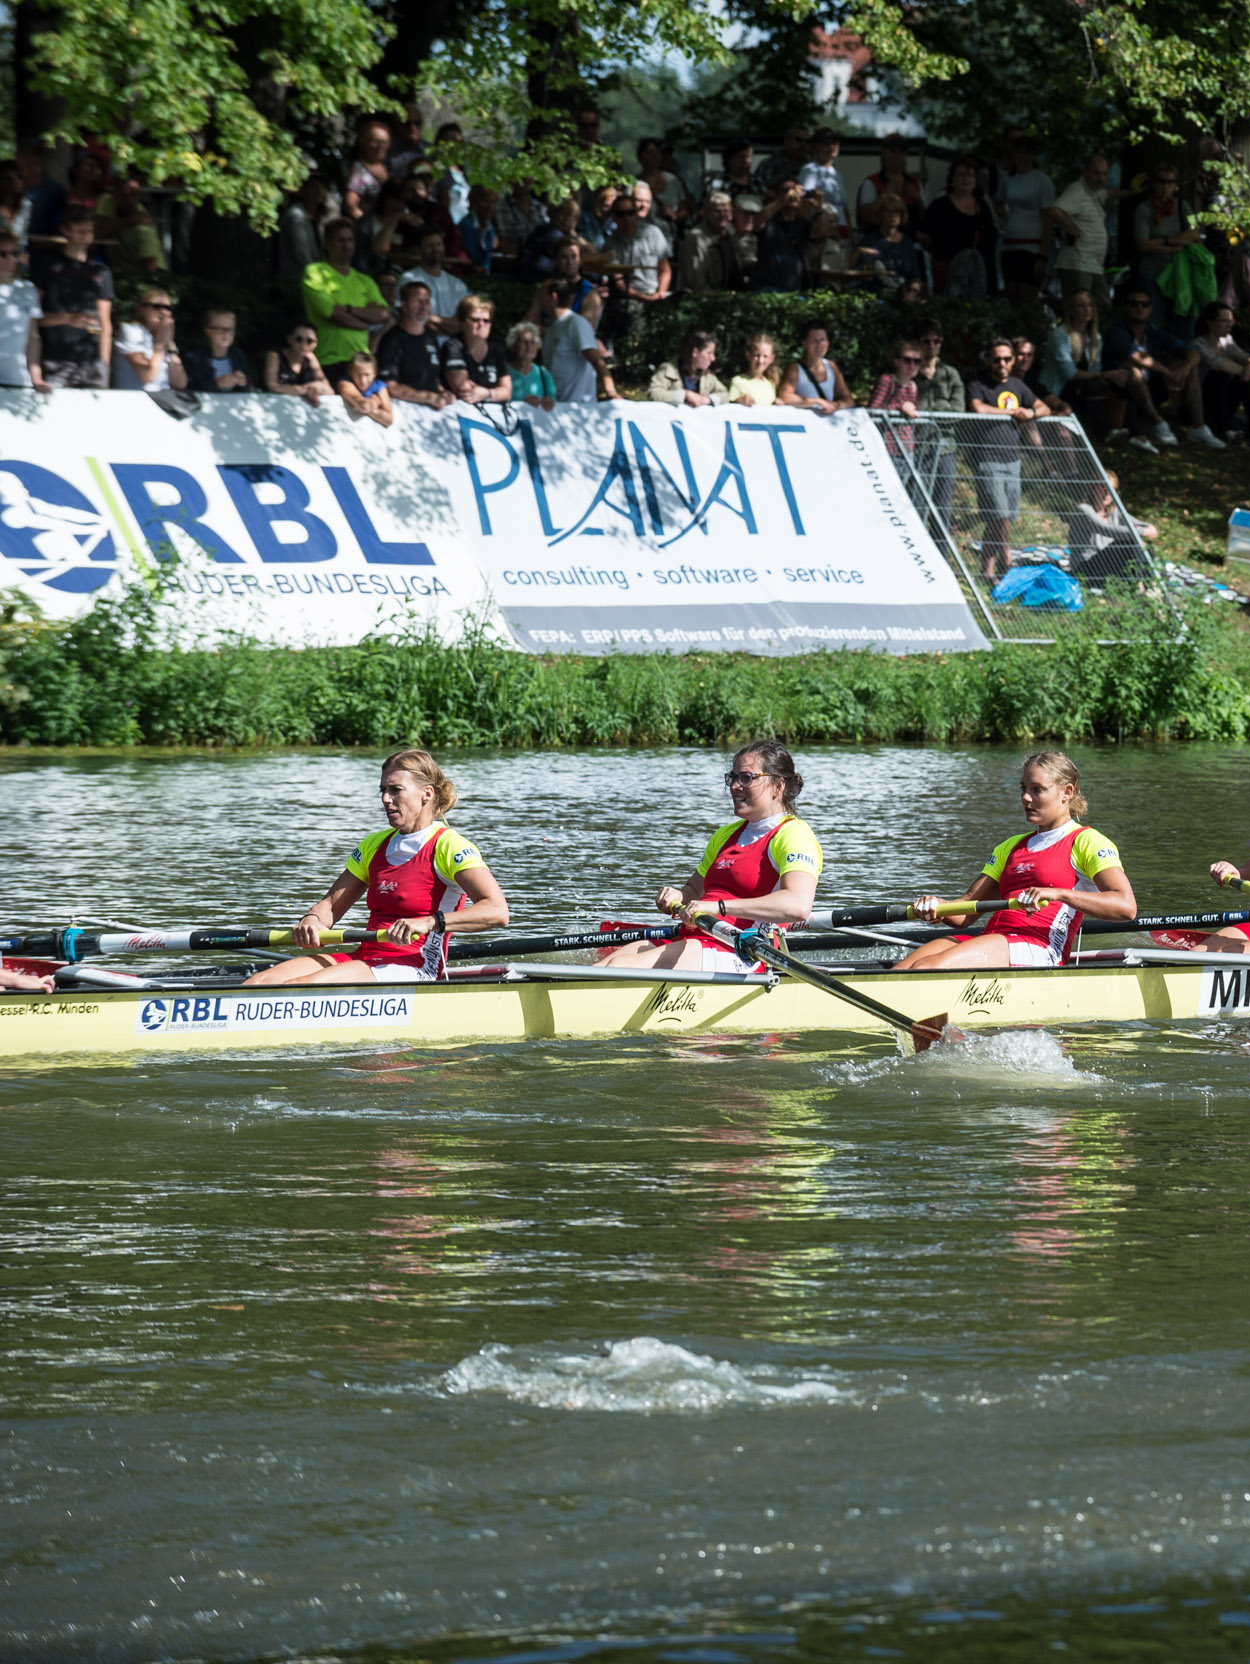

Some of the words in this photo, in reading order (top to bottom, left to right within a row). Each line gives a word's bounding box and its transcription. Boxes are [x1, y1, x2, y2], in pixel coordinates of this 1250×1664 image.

[457, 414, 806, 547] PLANAT
[109, 462, 436, 566] RBL
[847, 425, 935, 584] www.planat.de
[503, 564, 629, 590] consulting
[655, 564, 758, 585] software
[785, 564, 865, 585] service
[654, 627, 722, 642] Software
[722, 626, 745, 641] für
[887, 626, 967, 641] Mittelstand
[1138, 916, 1164, 926] STARK.
[1165, 914, 1200, 924] SCHNELL.
[1201, 913, 1220, 922] GUT.
[1228, 912, 1244, 920] RBL
[122, 935, 169, 950] Melitta
[554, 936, 582, 947] STARK.
[583, 932, 621, 944] SCHNELL.
[621, 931, 641, 941] GUT.
[643, 981, 699, 1015] Melitta
[954, 974, 1005, 1007] Melitta
[0, 1003, 53, 1015] essel-R.C.
[57, 1001, 99, 1014] Minden
[171, 997, 228, 1022] RBL
[235, 998, 408, 1021] RUDER-BUNDESLIGA
